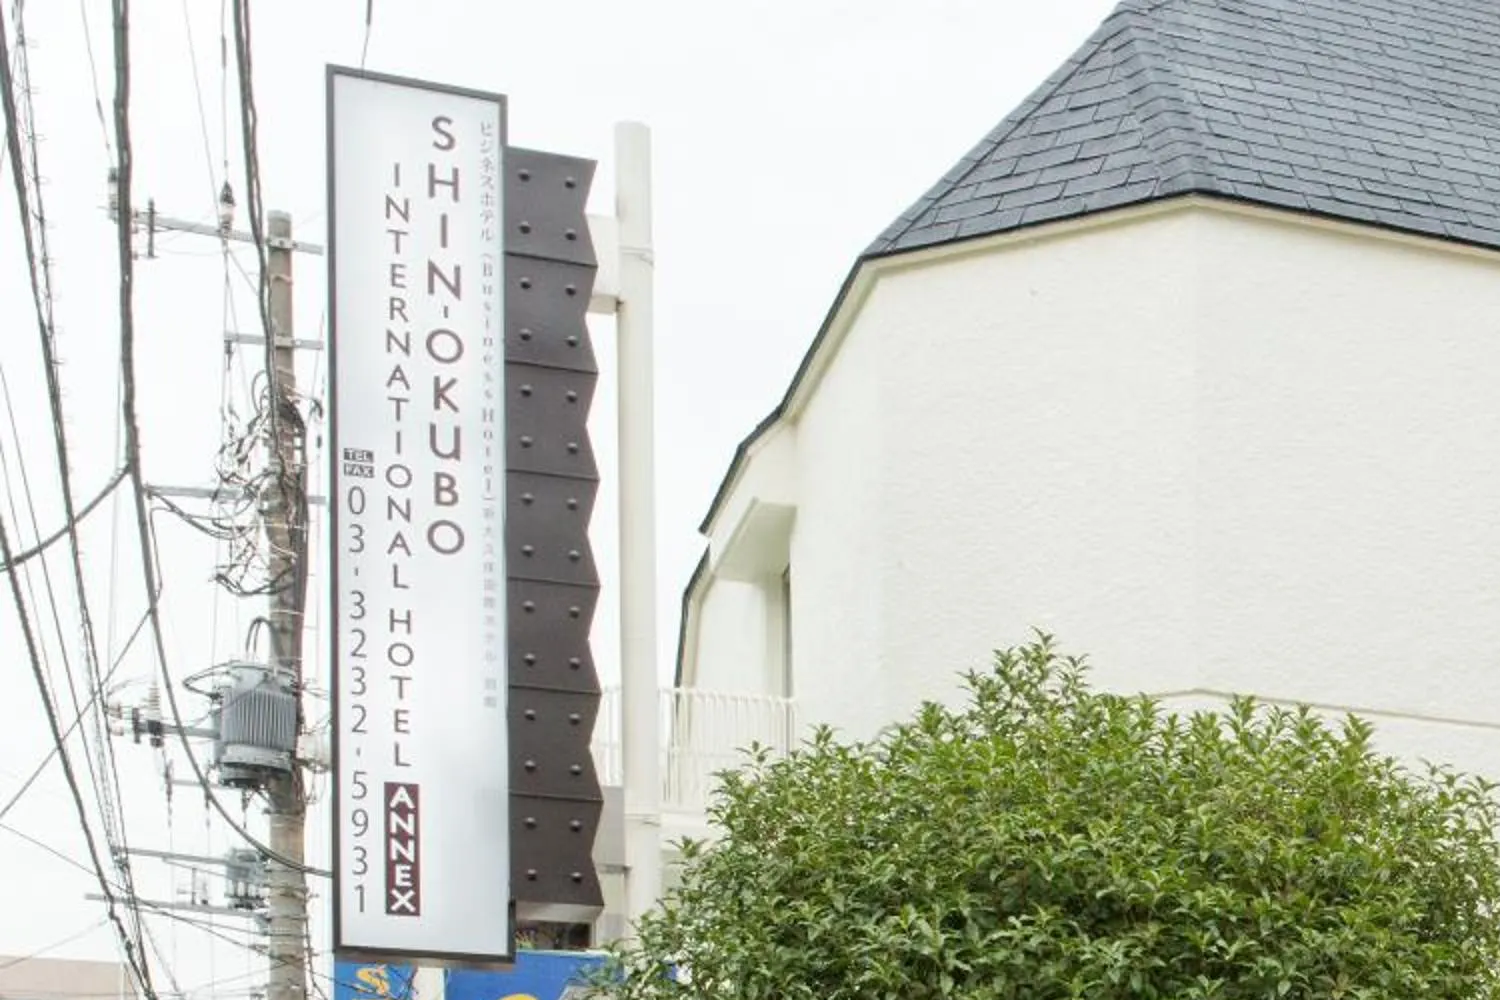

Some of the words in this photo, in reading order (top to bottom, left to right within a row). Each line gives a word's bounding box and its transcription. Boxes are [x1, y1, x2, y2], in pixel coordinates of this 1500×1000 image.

[385, 162, 413, 590] INTERNATIONAL
[425, 115, 465, 555] SHIN-OKUBO
[347, 485, 369, 913] 03-3232-5931
[387, 607, 414, 768] HOTEL
[389, 784, 416, 913] ANNEX
